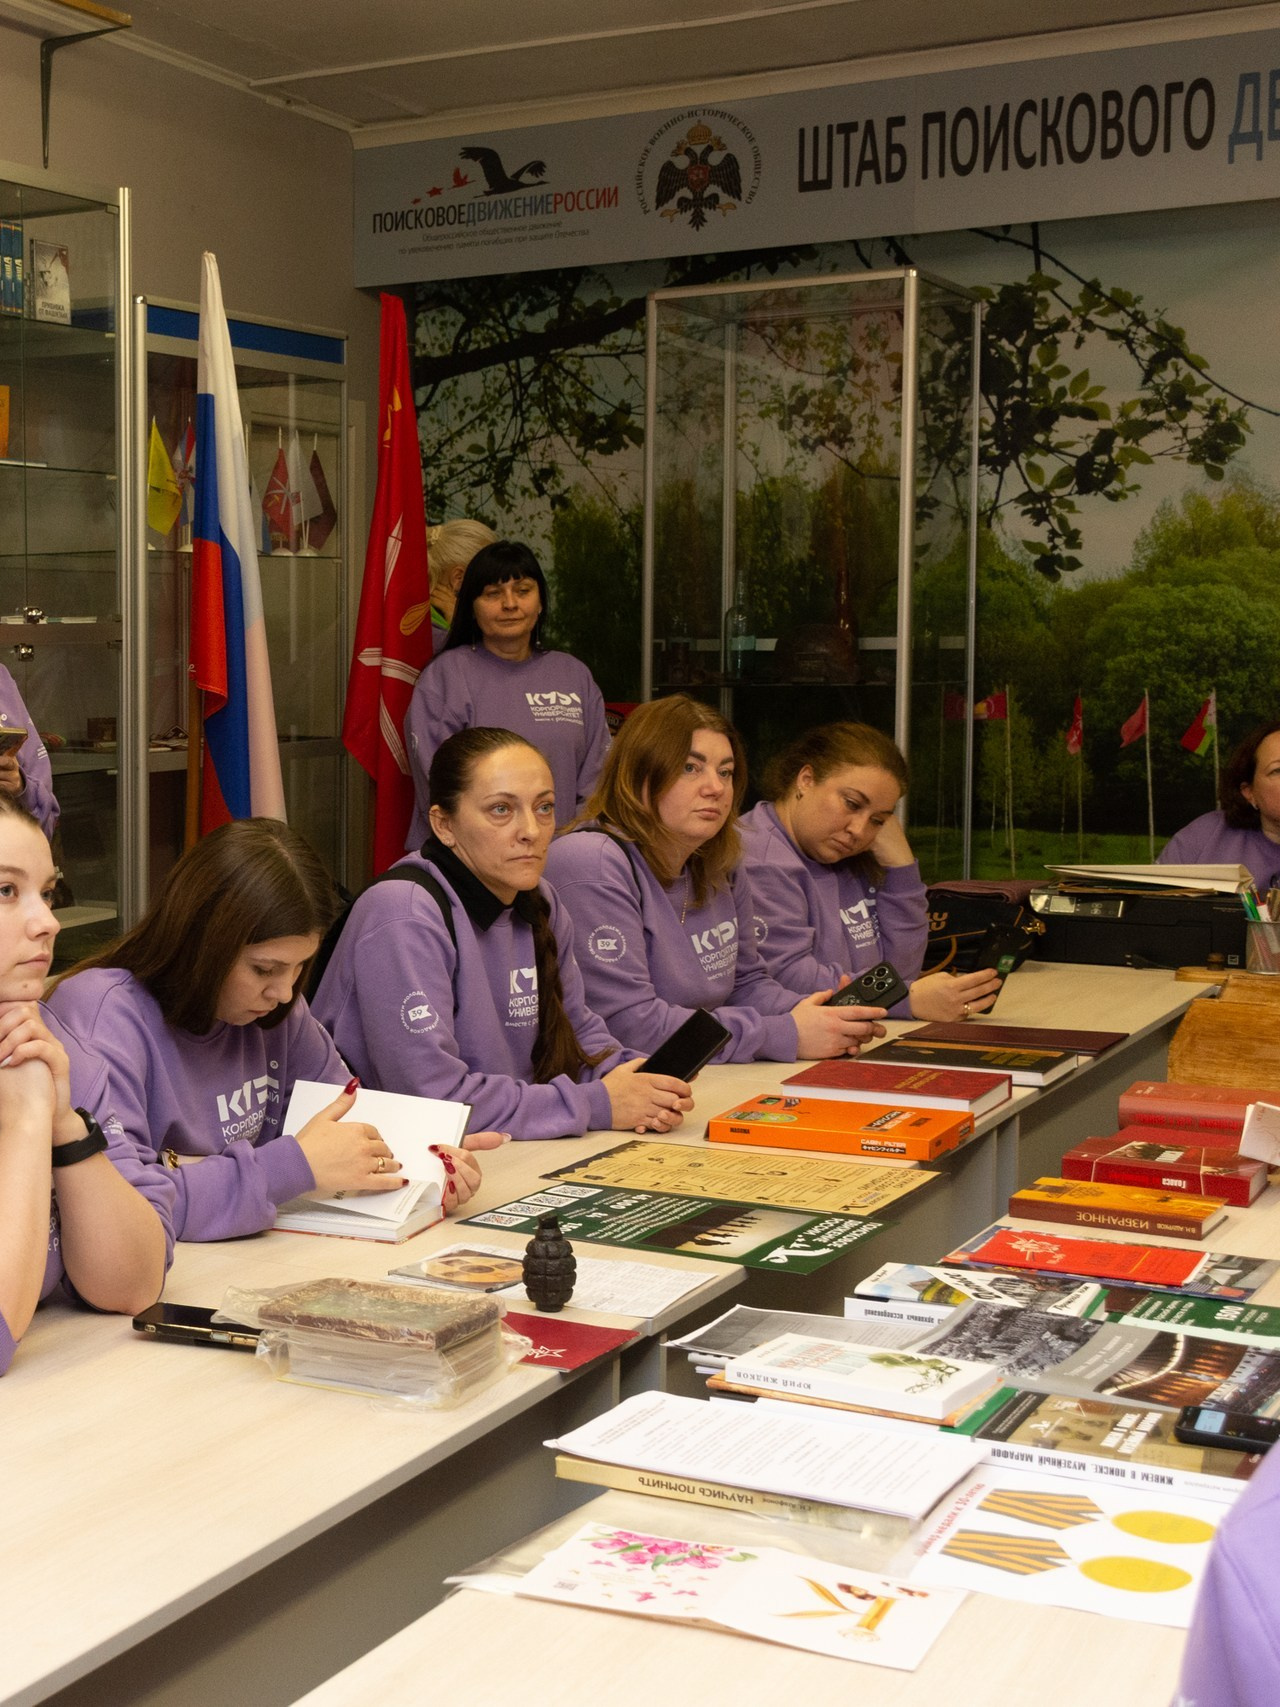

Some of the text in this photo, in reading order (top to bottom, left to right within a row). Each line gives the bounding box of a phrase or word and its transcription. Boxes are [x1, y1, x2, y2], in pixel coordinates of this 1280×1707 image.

[797, 115, 907, 193] ШТАБ
[921, 77, 1216, 182] ПОИСКОВОГО
[599, 939, 611, 949] 39
[411, 1008, 423, 1018] 39
[860, 1138, 907, 1148] CABIN FILTER
[1075, 1211, 1151, 1231] ИЗБРАННОЕ
[736, 1371, 812, 1390] ЮРИЙ ЖИДКОВ
[991, 1447, 1034, 1463] МАРАФОН
[1038, 1455, 1087, 1472] МУЗЕЙНЫЙ
[1130, 1470, 1137, 1480] В
[1140, 1471, 1174, 1486] ЖИВЕМ
[637, 1475, 696, 1494] ПОМНИТЬ
[698, 1486, 754, 1505] НАУЧИСЬ
